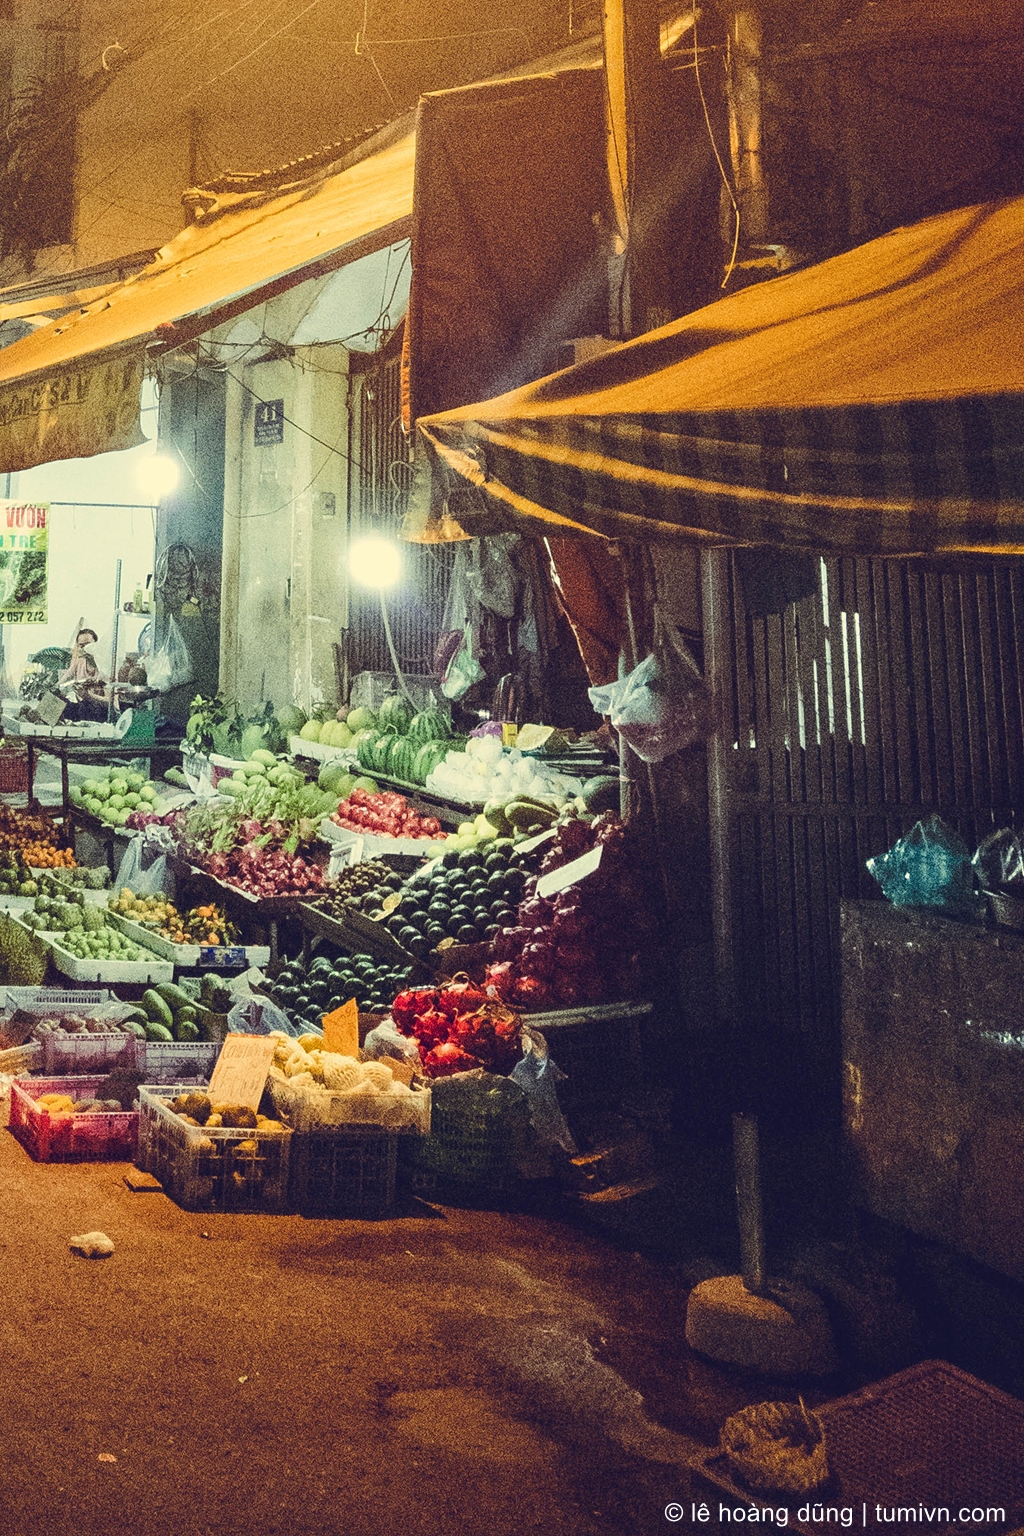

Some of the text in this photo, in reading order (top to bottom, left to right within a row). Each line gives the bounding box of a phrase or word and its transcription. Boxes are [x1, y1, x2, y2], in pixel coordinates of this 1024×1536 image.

[260, 405, 277, 423] 41
[9, 535, 36, 549] TRE
[7, 611, 24, 622] 057
